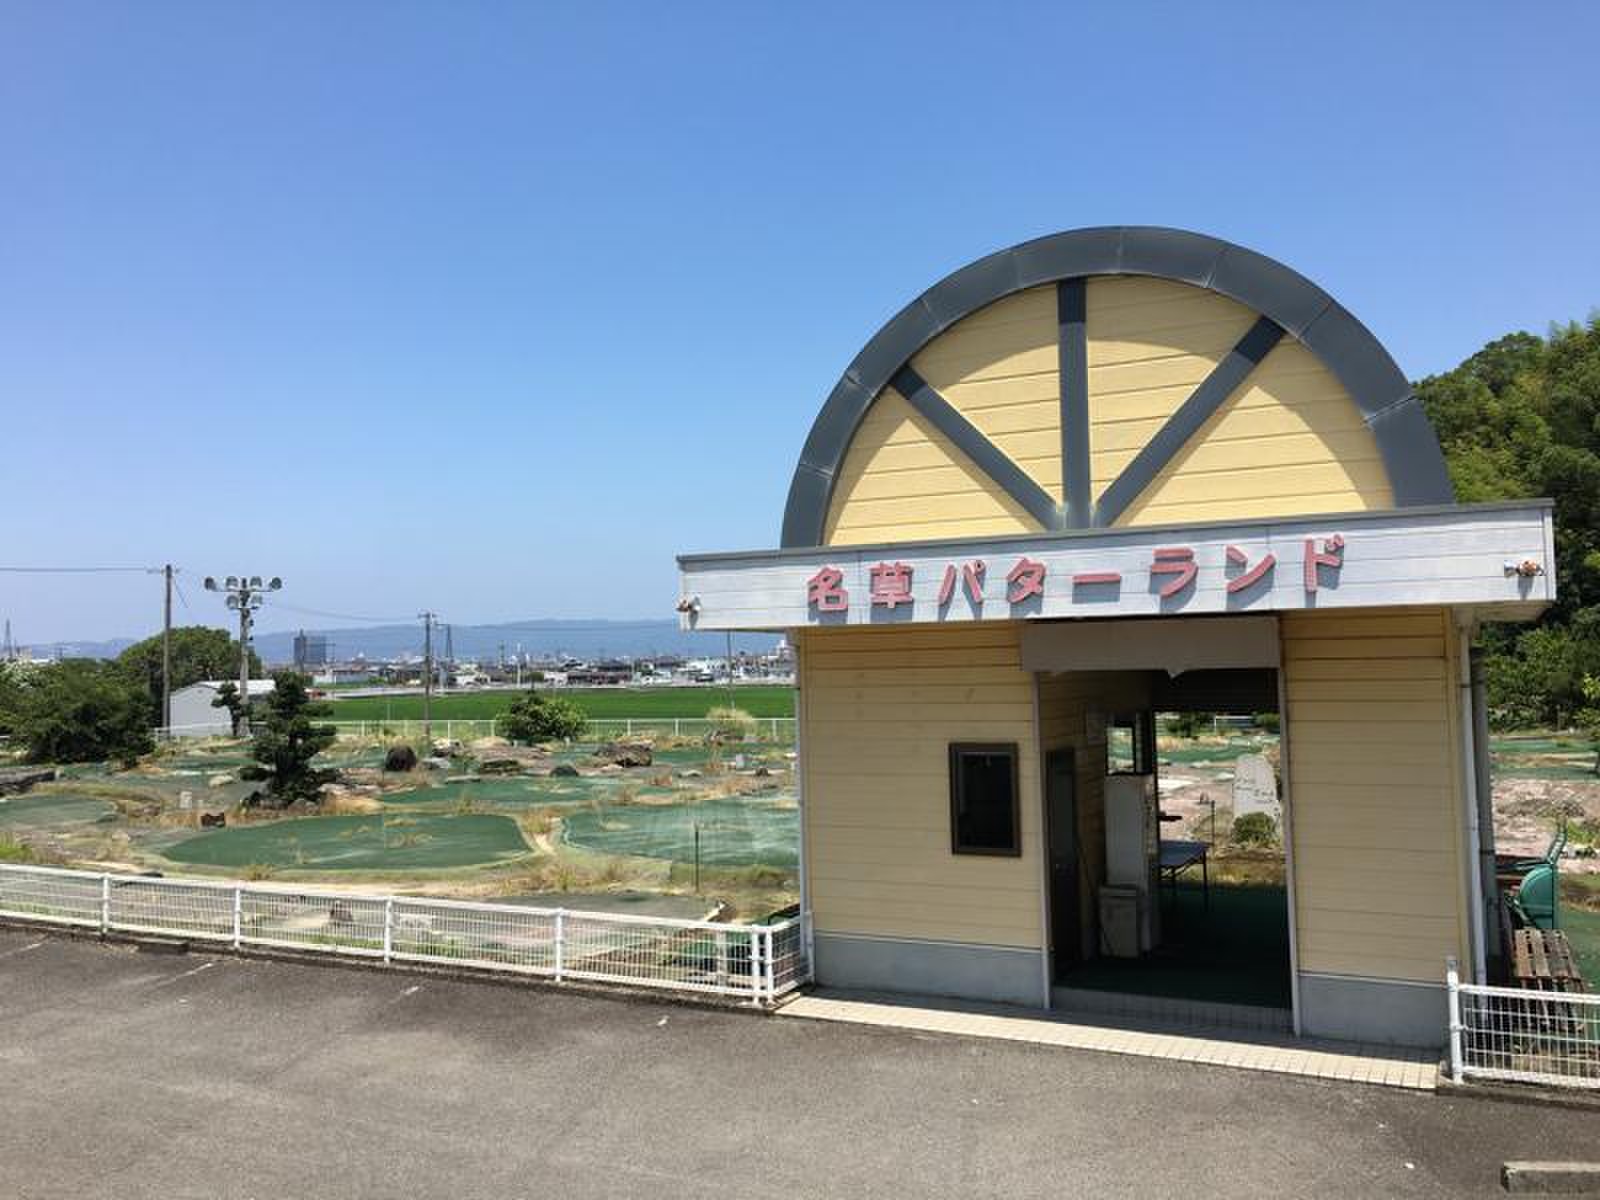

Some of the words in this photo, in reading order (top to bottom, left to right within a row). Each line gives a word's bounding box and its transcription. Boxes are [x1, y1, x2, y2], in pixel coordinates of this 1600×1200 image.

[807, 535, 1344, 611] 名草パターランド
